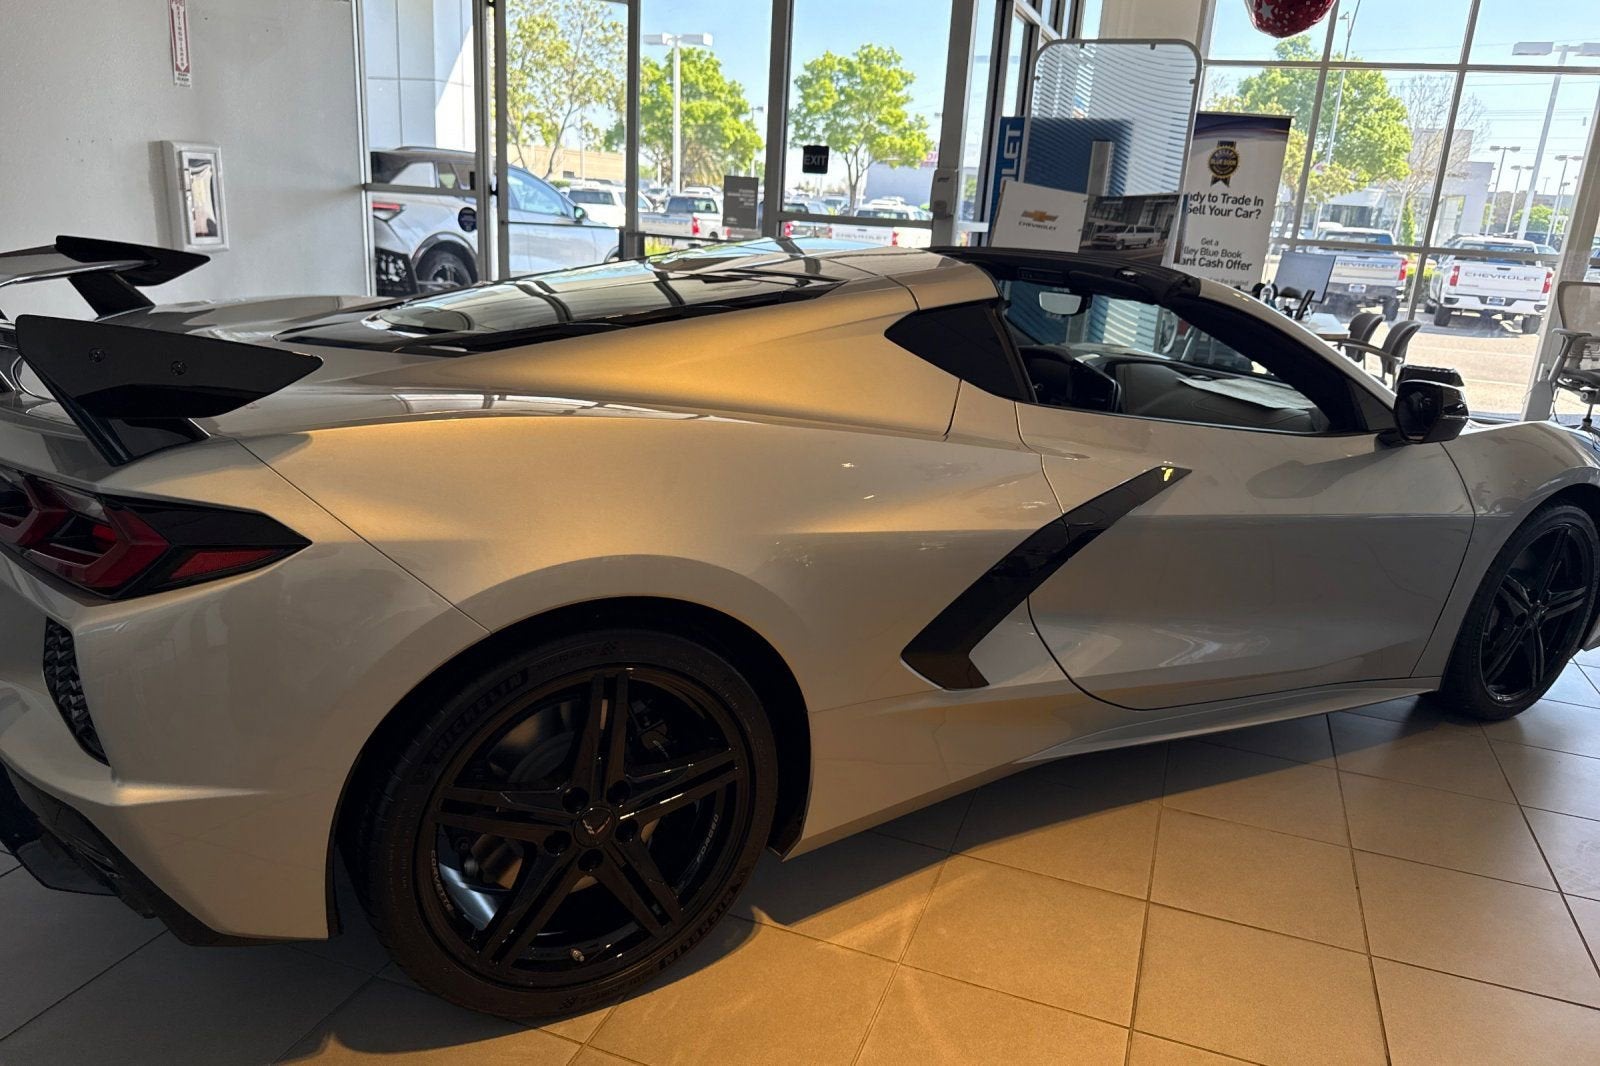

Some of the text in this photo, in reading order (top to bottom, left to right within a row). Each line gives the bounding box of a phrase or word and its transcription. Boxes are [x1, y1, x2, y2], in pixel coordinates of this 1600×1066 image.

[804, 154, 828, 166] EXIT
[1208, 193, 1218, 203] to
[1221, 194, 1251, 206] Trade
[1254, 196, 1264, 206] In
[1209, 205, 1233, 217] Your
[1235, 208, 1262, 219] Car?
[1018, 221, 1057, 231] CHEVROLET
[1201, 238, 1213, 246] Get
[1200, 247, 1219, 257] Blue
[1221, 249, 1242, 259] Book
[1198, 257, 1223, 268] Cash
[1226, 259, 1252, 270] Offer
[1335, 261, 1395, 270] HEVROLET
[1464, 271, 1539, 282] CHEVROLET
[696, 813, 719, 863] FORGED
[430, 849, 454, 912] CORVETTE
